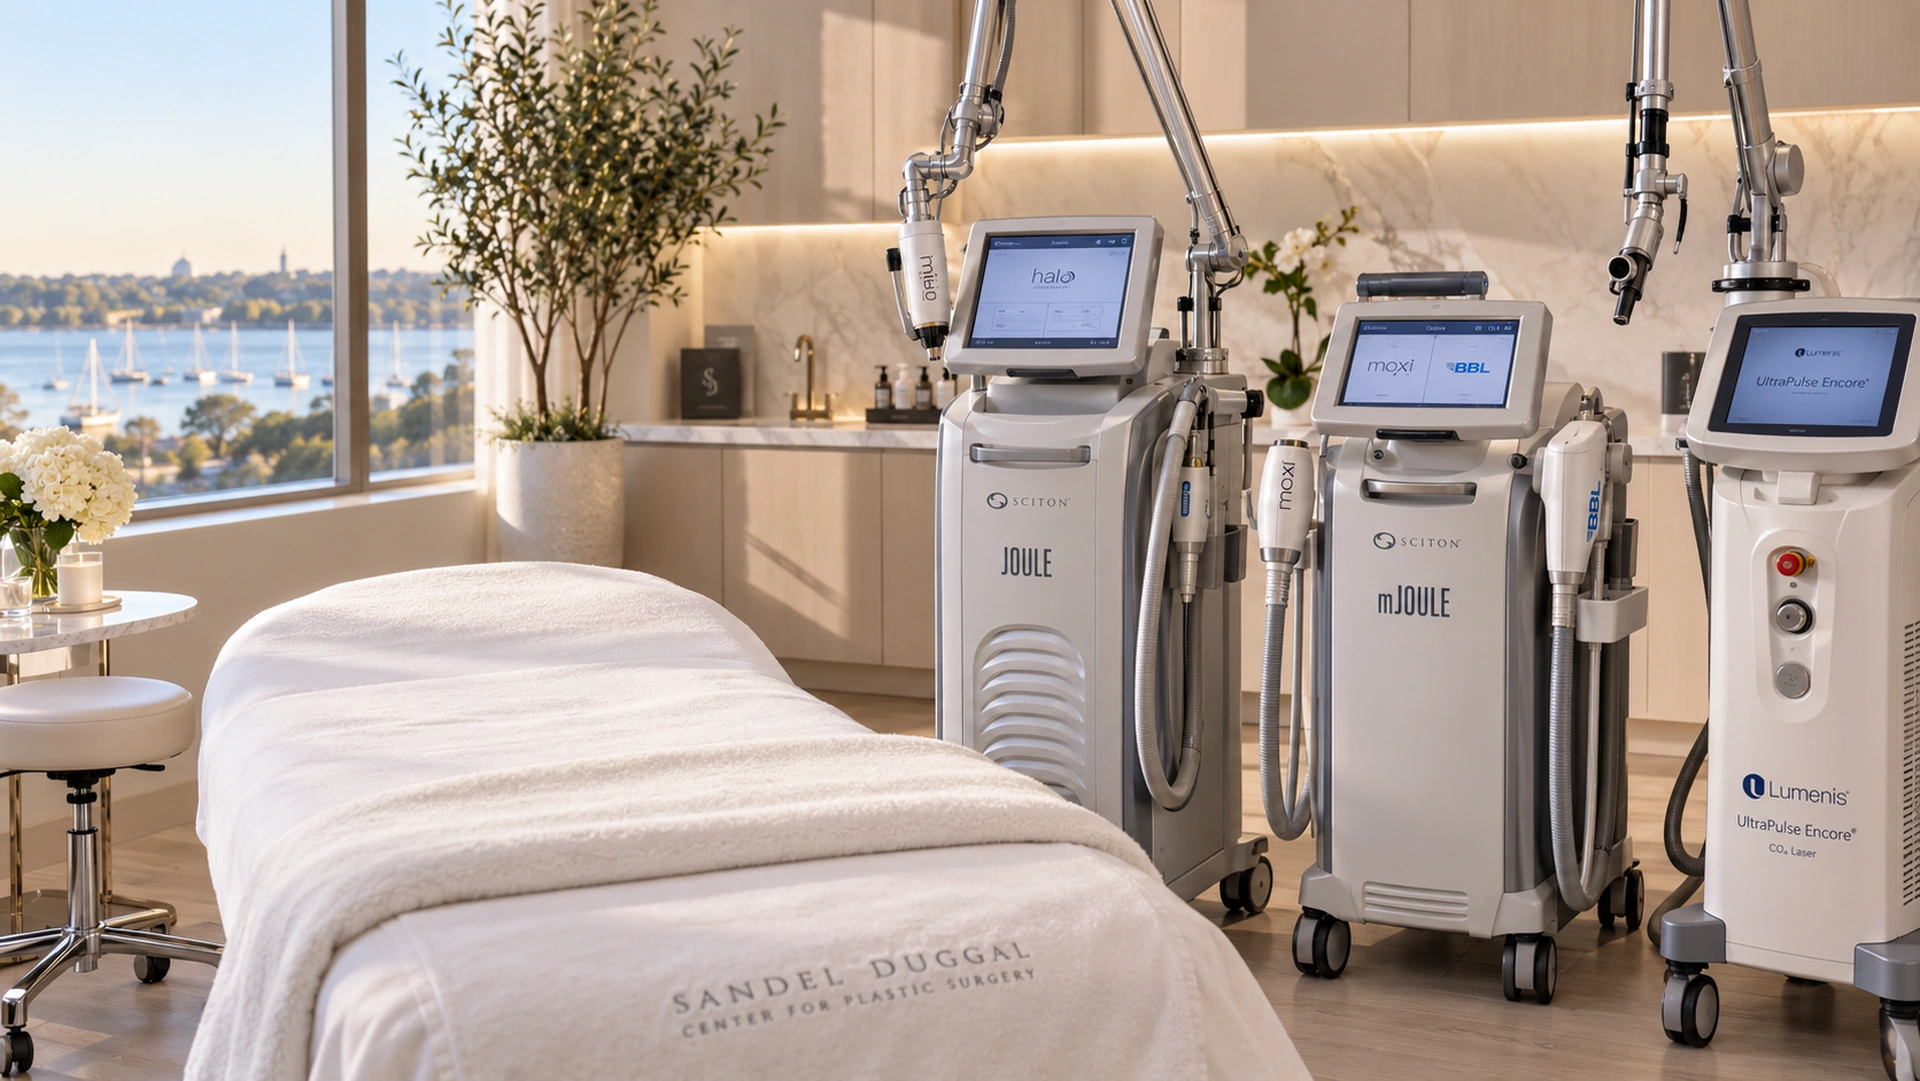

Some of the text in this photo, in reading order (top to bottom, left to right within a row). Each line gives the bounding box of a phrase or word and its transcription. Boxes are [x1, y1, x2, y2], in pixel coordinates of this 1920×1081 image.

[1031, 268, 1076, 284] halo
[1367, 359, 1415, 375] moxi
[1454, 362, 1490, 374] BBL
[1756, 376, 1819, 388] UltraPulse
[1279, 460, 1296, 510] moxi
[1012, 497, 1069, 508] SCITON
[1587, 480, 1602, 531] BBL
[1401, 537, 1460, 549] SCITON
[1001, 546, 1052, 578] JOULE
[1378, 585, 1451, 618] mJOULE
[1736, 814, 1802, 836] UltraPulse
[1791, 846, 1817, 858] Laser
[672, 941, 1032, 1015] SANDEL DUGGAL
[682, 968, 1036, 1039] CENTER FOR PLASTIC SURGERY
